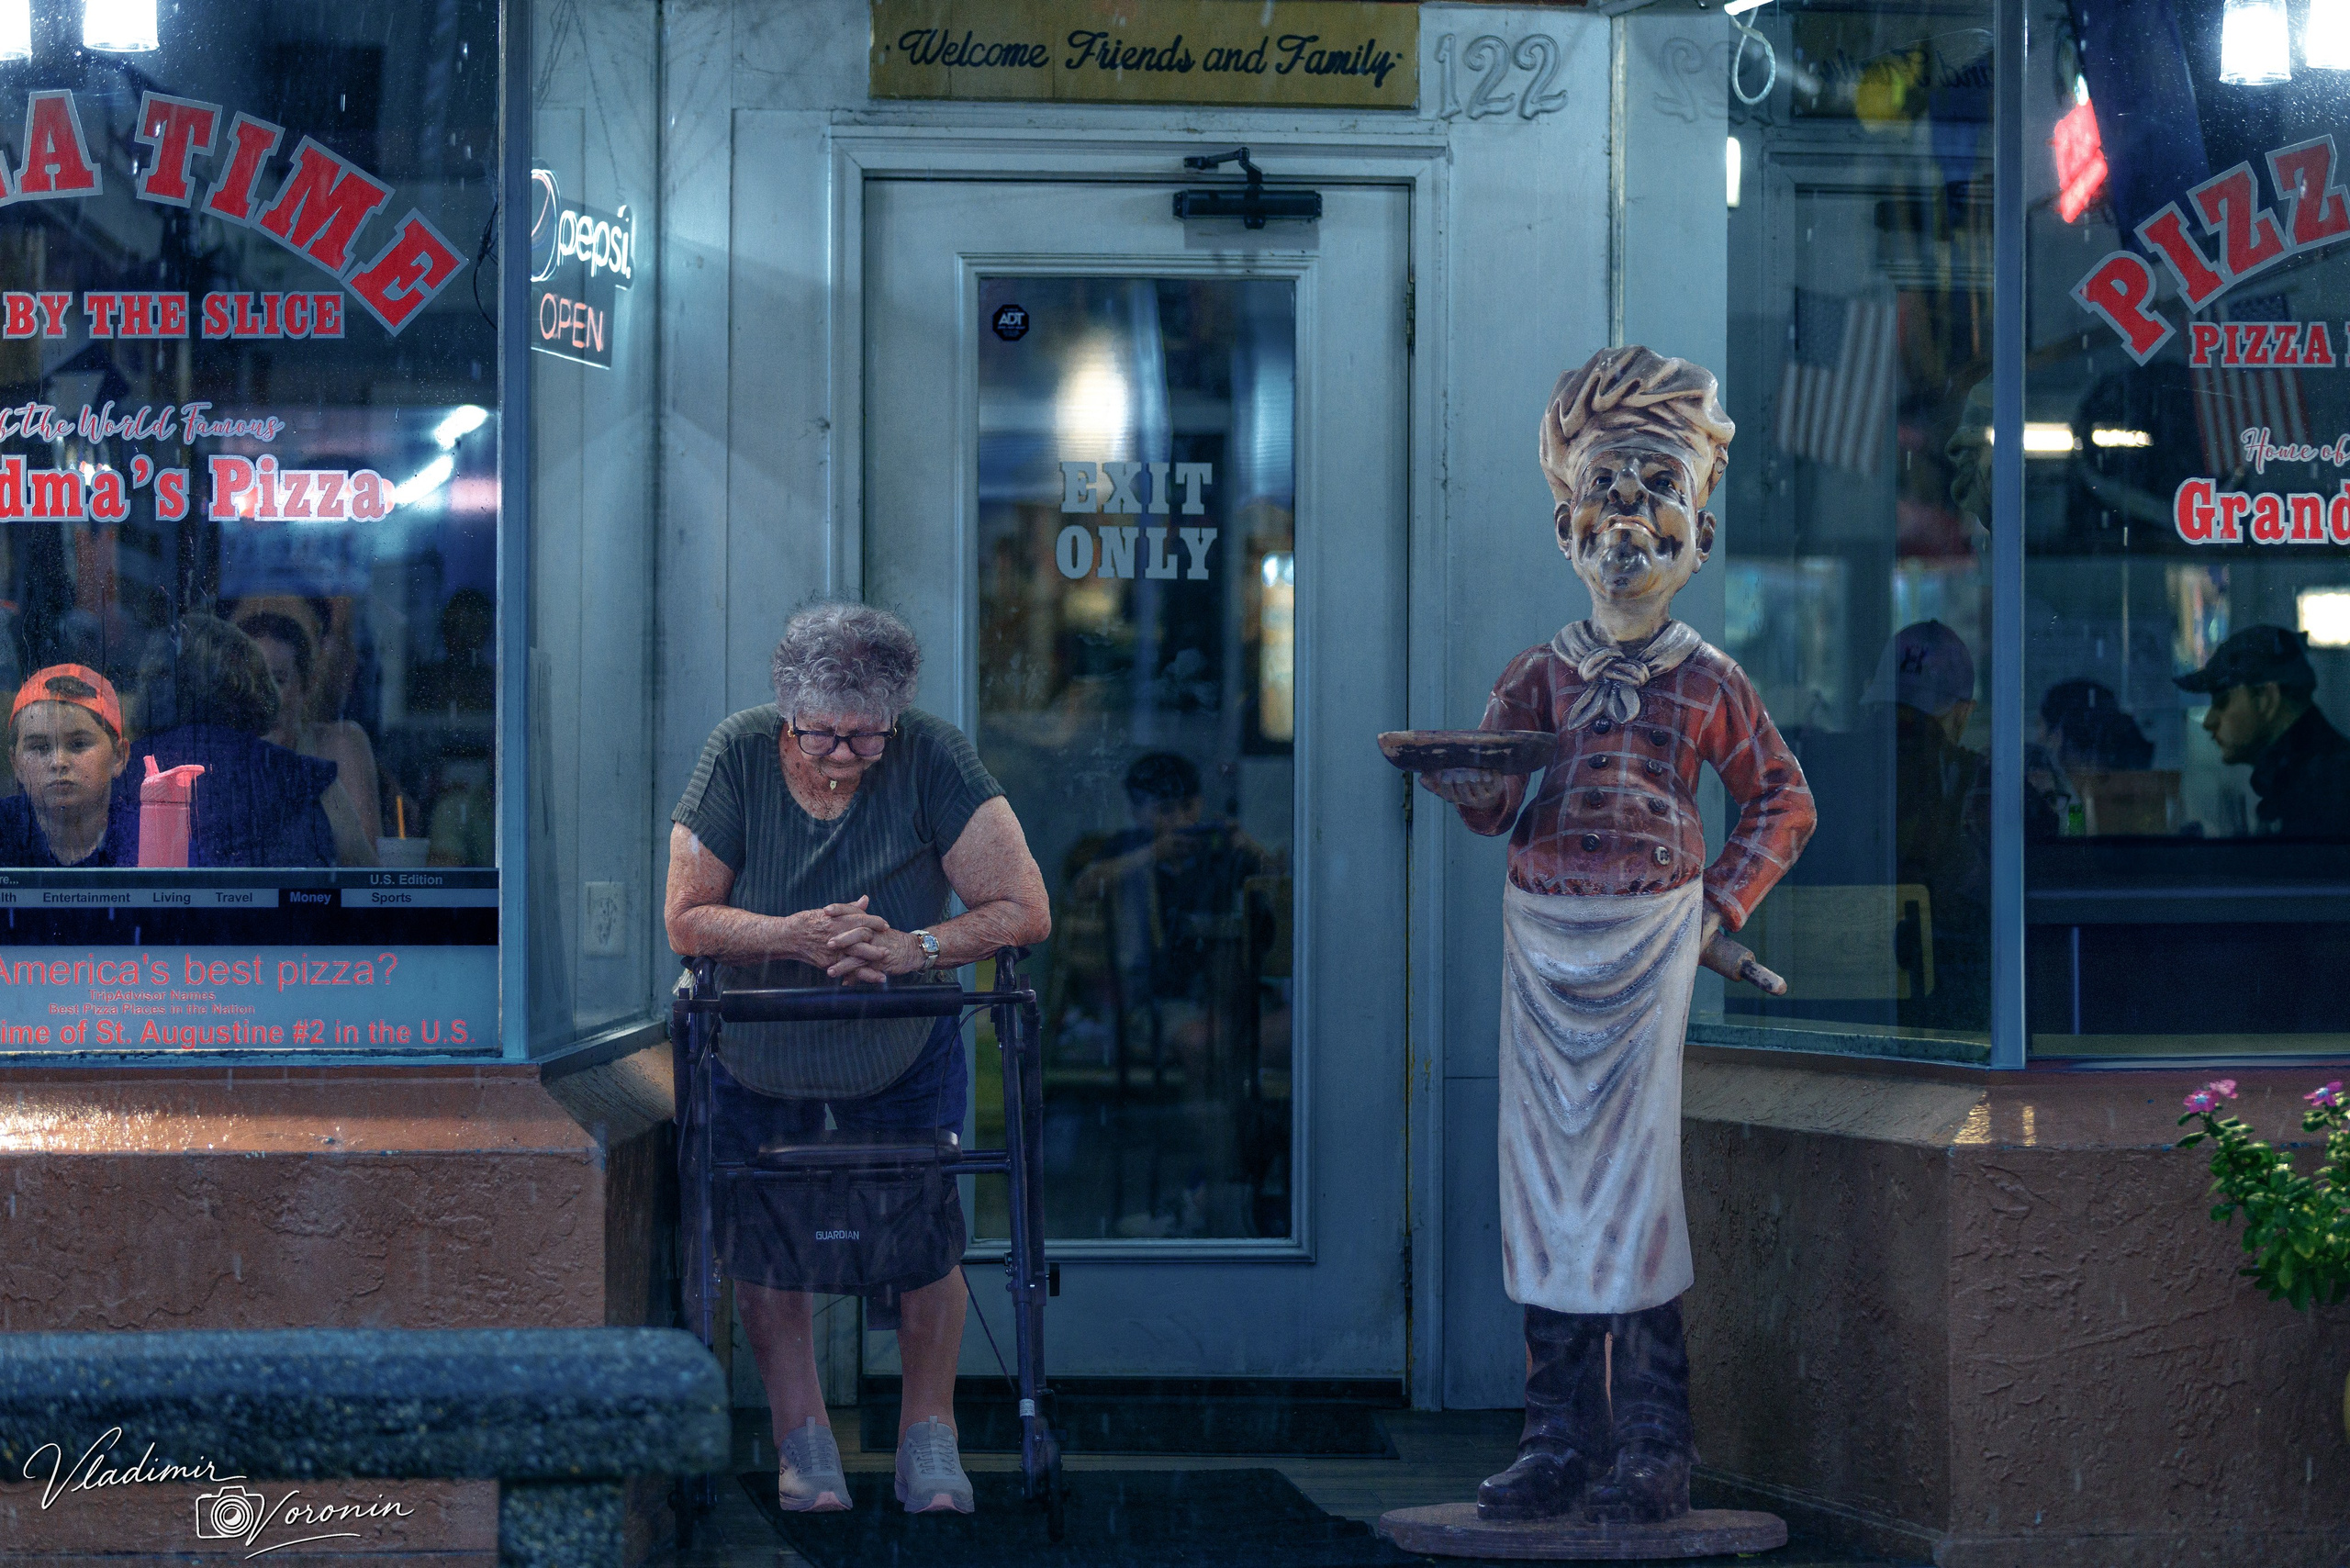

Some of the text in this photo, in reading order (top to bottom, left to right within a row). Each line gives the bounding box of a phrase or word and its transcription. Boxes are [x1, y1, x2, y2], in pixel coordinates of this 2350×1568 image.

[897, 28, 1397, 88] Welcome Friends and Family
[1435, 33, 1567, 120] 122
[0, 89, 467, 337] A TIME
[557, 204, 632, 279] pepsi
[2070, 133, 2350, 365] PIZZ
[4, 291, 345, 340] BY THE SLICE
[540, 293, 604, 352] OPEN
[999, 312, 1025, 325] ADT
[2188, 321, 2336, 368] PIZZA
[14, 401, 76, 442] the
[77, 399, 178, 444] World
[181, 401, 285, 445] Famous
[2240, 426, 2350, 475] Home of
[208, 454, 390, 522] Pizza
[1058, 461, 1213, 515] EXIT
[2173, 476, 2350, 545] Grand
[1056, 524, 1218, 580] ONLY
[42, 891, 131, 902] Entertainment
[152, 891, 191, 905] Living
[215, 891, 253, 902] Travel
[289, 891, 331, 905] Money
[371, 891, 412, 905] Sports
[370, 874, 396, 886] U.S.
[398, 874, 443, 886] Edition
[88, 989, 217, 1002] TripAdvisor Names
[184, 953, 264, 986] best
[277, 952, 398, 993] pizza?
[49, 1002, 255, 1015] Best Pizza Places in the Nation
[60, 1019, 88, 1045] of
[95, 1019, 131, 1045] St.
[140, 1019, 285, 1050] Augustine
[292, 1019, 326, 1045] #2
[334, 1019, 359, 1045] in
[368, 1019, 411, 1045] the
[421, 1019, 476, 1045] U.S.
[815, 1229, 860, 1240] GUARDIAN
